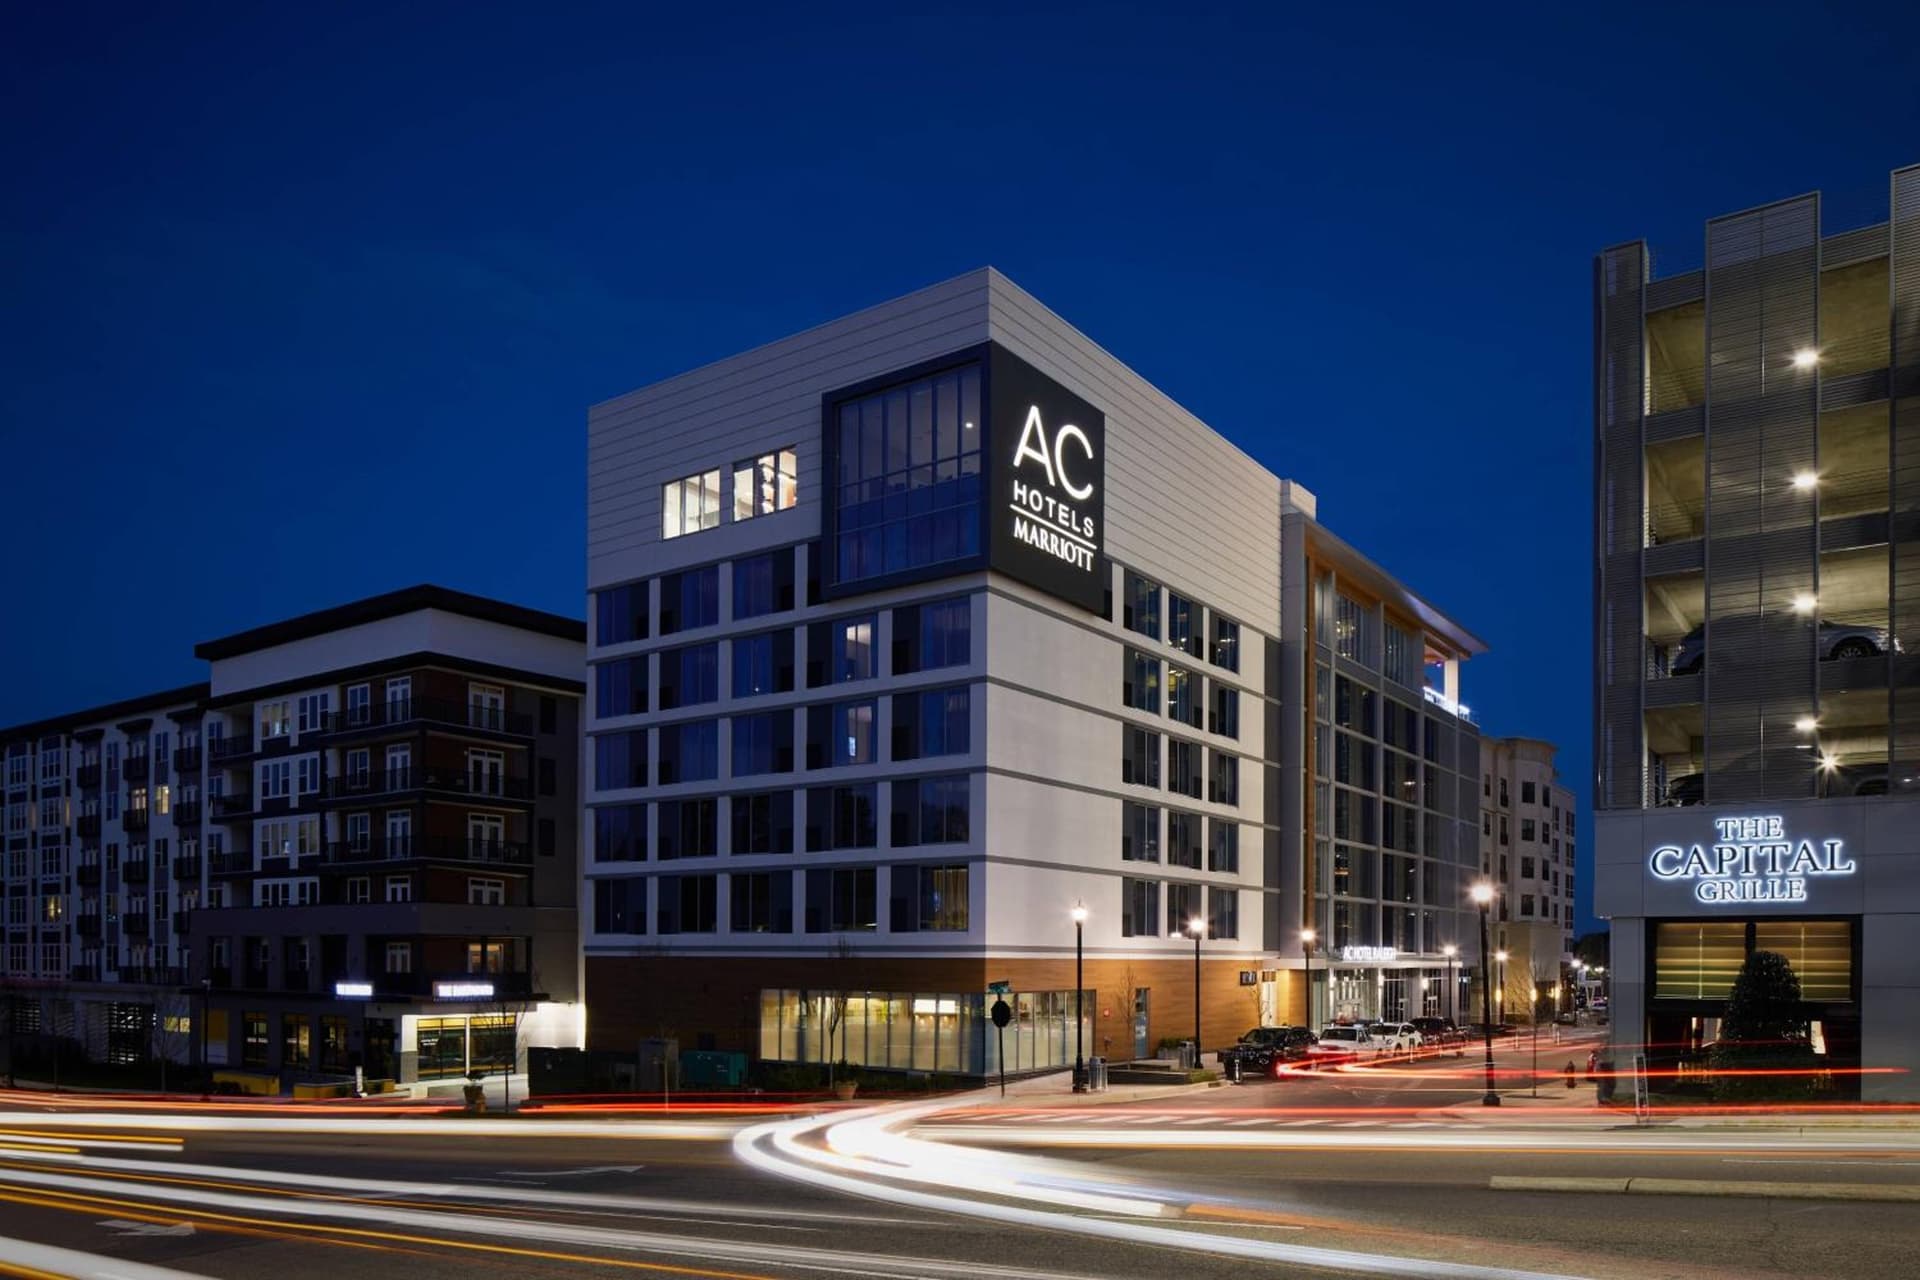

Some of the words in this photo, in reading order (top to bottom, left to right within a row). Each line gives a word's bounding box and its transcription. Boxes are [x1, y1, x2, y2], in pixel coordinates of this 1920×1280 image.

[1013, 404, 1094, 500] AC
[1013, 479, 1095, 538] HOTELS
[1013, 516, 1095, 572] MARRIOTT
[1717, 816, 1783, 840] THE
[1651, 840, 1855, 878] CAPITAL
[1696, 879, 1806, 902] GRILLE
